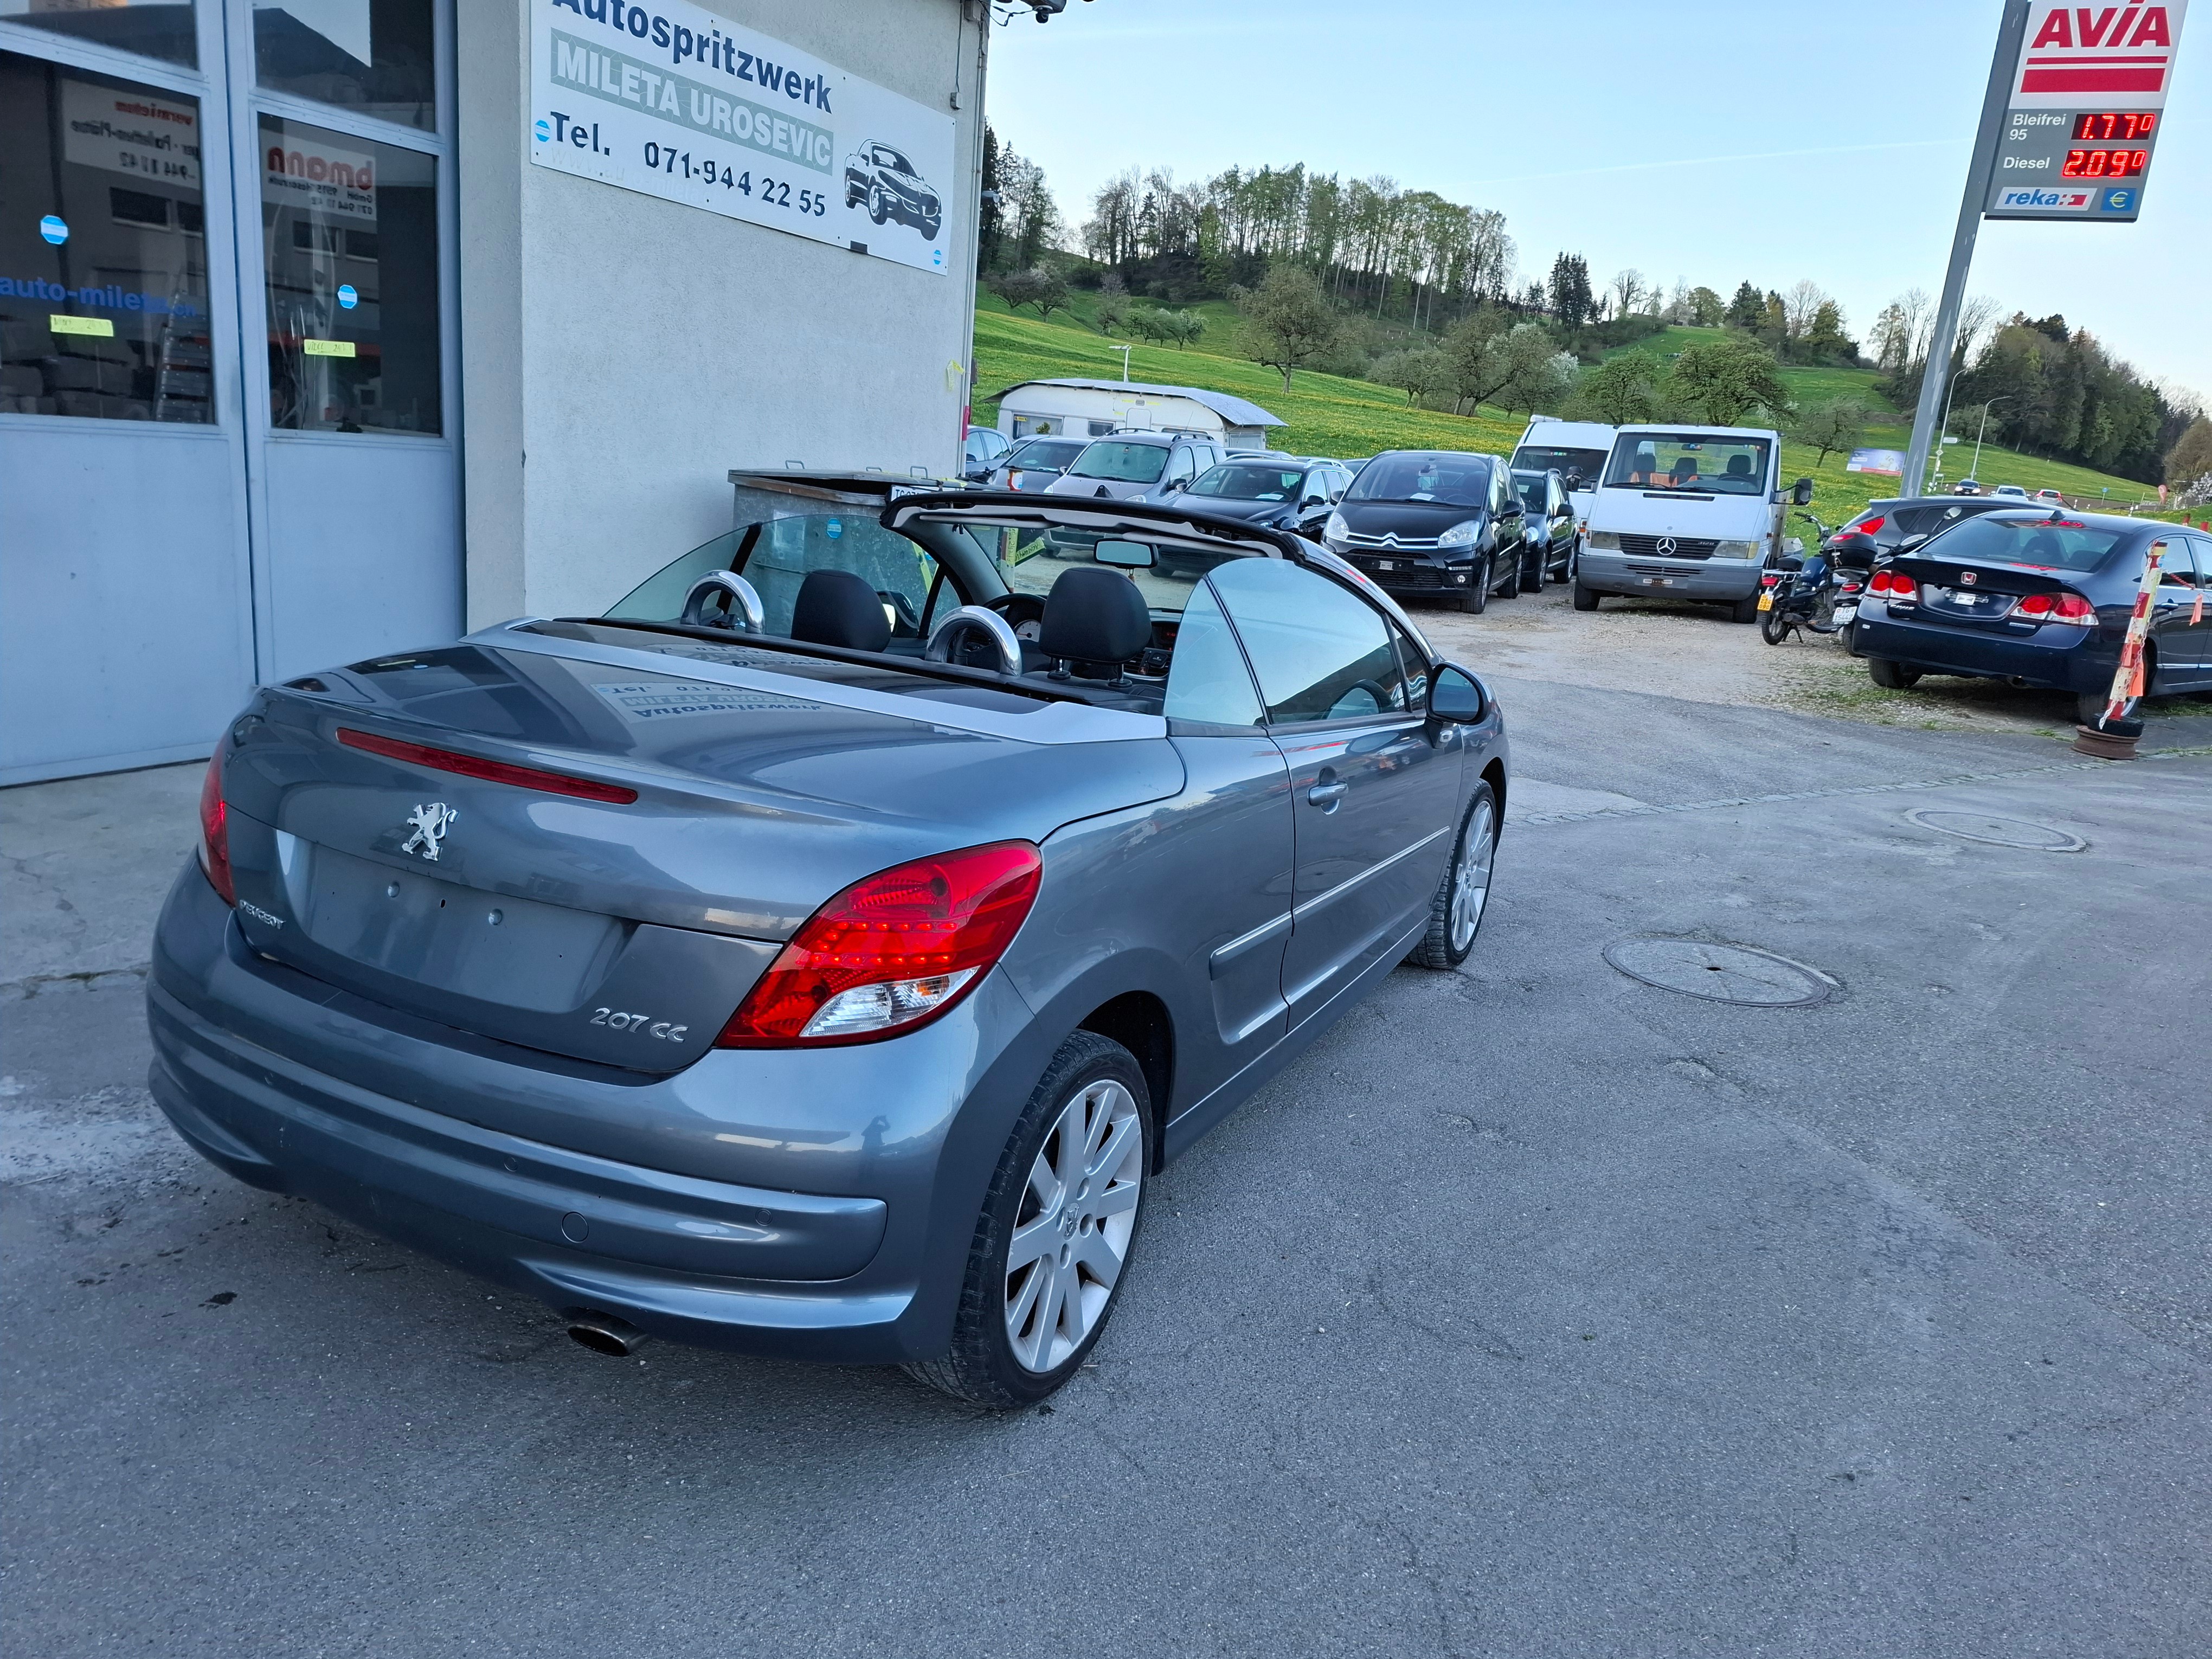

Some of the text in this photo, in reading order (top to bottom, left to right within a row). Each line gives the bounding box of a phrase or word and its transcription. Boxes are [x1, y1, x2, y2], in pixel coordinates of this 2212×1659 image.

[2030, 0, 2170, 48] AVIA
[552, 0, 832, 114] utospritzwerk
[558, 40, 831, 166] MILETA UROSEVIC
[2012, 114, 2066, 125] Bleifrei
[2009, 129, 2028, 140] 95
[550, 111, 825, 216] Tel. 071-944 22 55
[2003, 157, 2050, 168] Diesel
[589, 1007, 689, 1043] 207 CC
